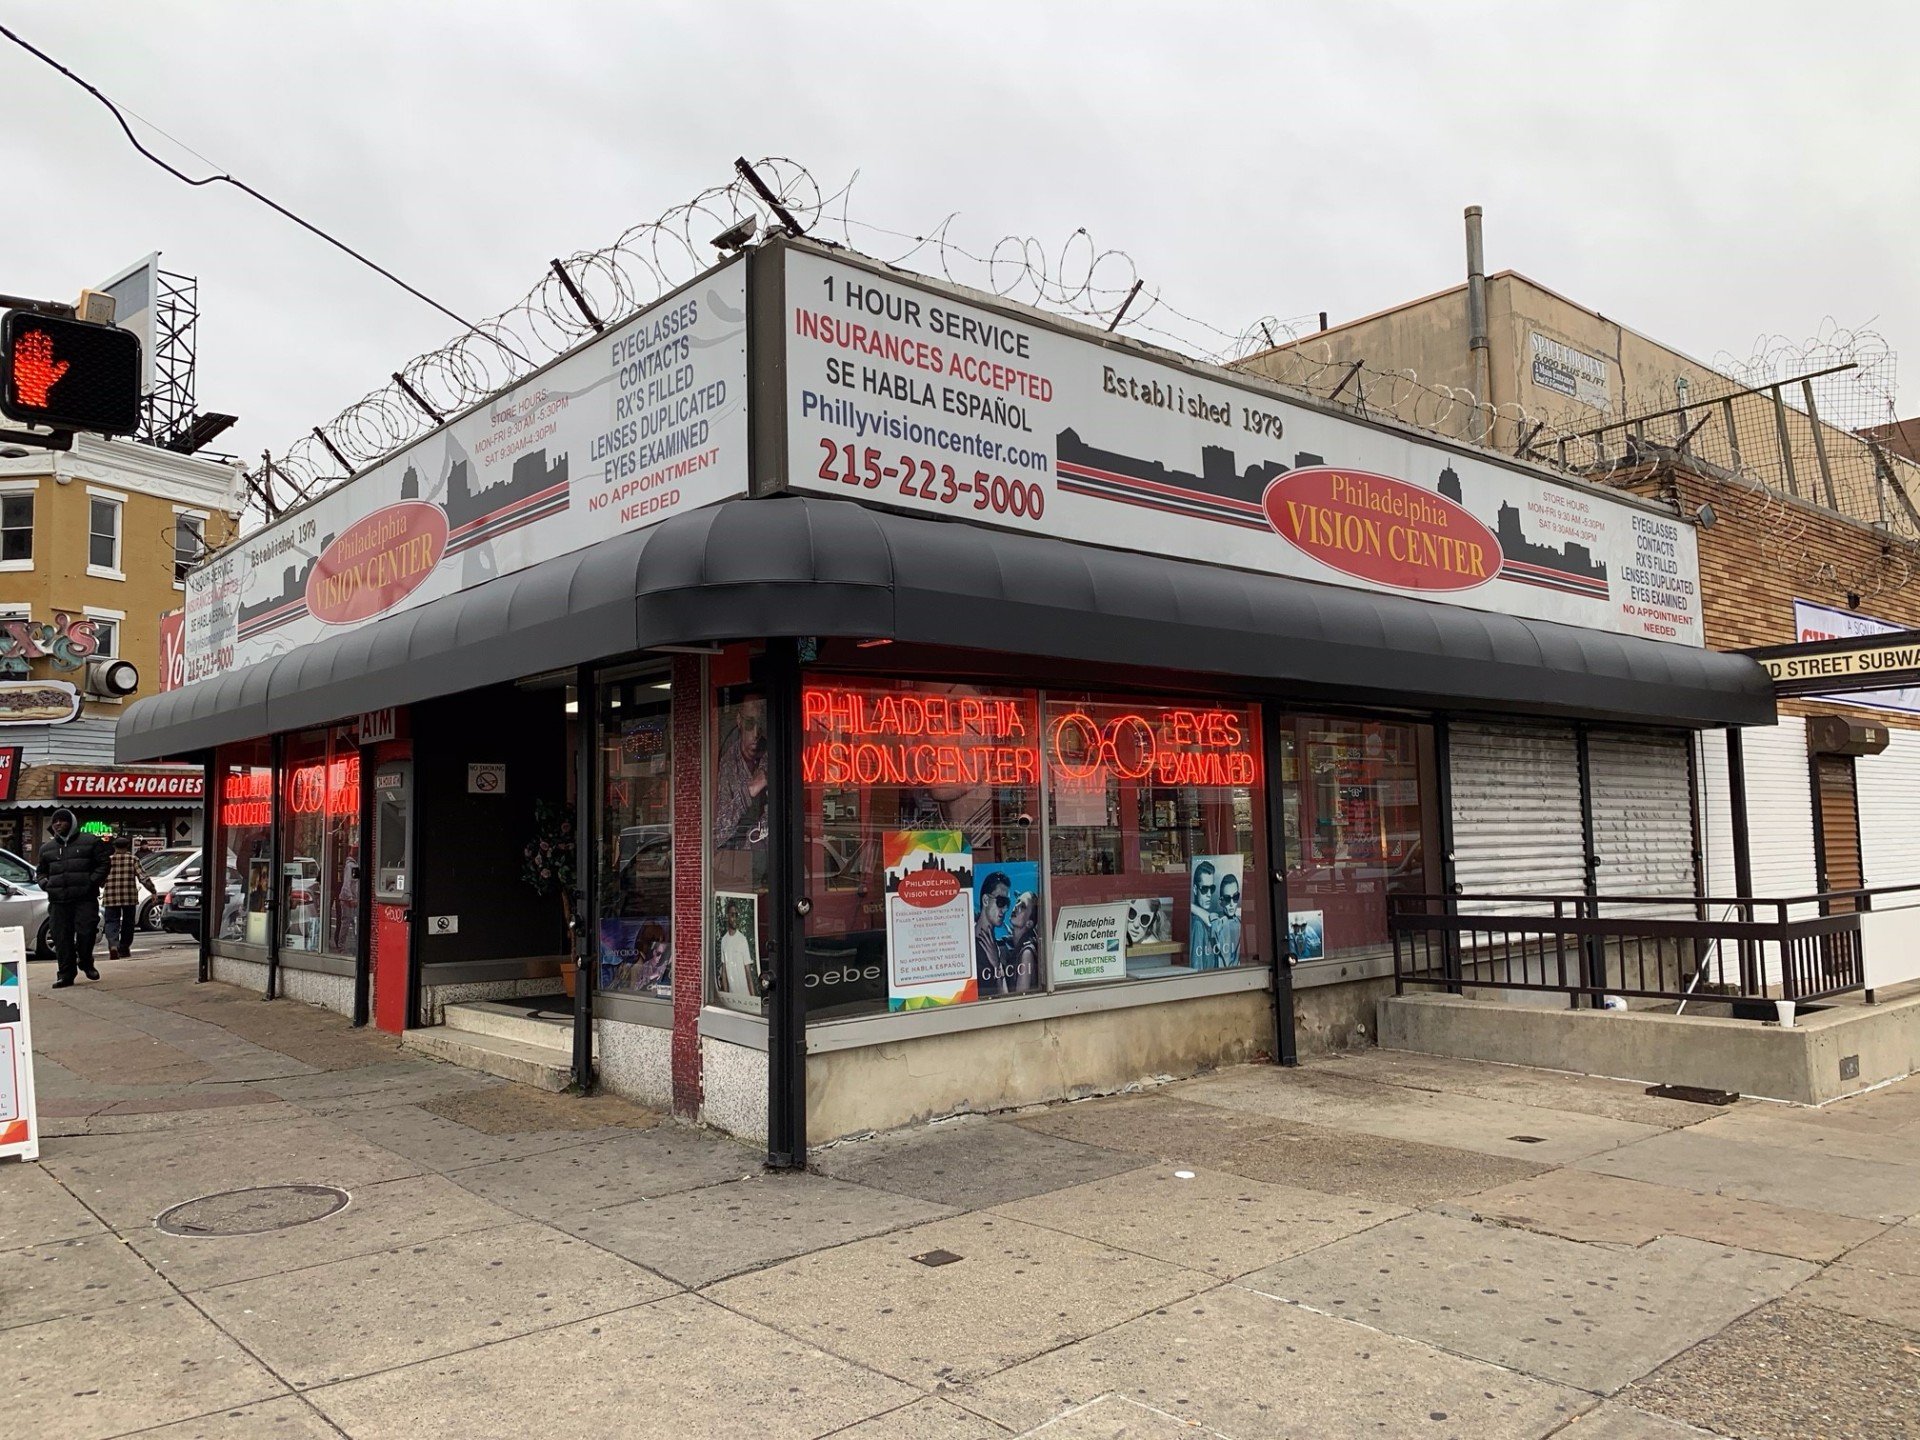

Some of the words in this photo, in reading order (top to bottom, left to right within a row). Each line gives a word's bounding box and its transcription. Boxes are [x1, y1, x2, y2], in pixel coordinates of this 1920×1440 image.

[824, 276, 834, 301] 1
[846, 281, 921, 328] HOUR
[929, 307, 1030, 359] SERVICE
[612, 300, 697, 367] EYEGLASSES
[620, 334, 689, 390] CONTACTS
[795, 307, 943, 373] INSURANCES
[950, 353, 1053, 403] ACCEPTED
[1560, 363, 1580, 378] PLUS
[616, 392, 644, 421] RX'S
[648, 364, 694, 407] FILLED
[826, 357, 855, 388] SE
[863, 367, 936, 409] HABLA
[943, 387, 1032, 432] ESPAÑOL
[1102, 365, 1232, 427] Established
[1243, 407, 1284, 440] 1979
[491, 405, 517, 428] STORE
[591, 420, 637, 462] LENSES
[641, 379, 726, 440] DUPLICATED
[802, 390, 1048, 472] Phillyvisioncenter.com
[475, 429, 506, 455] MON-FRI
[523, 413, 536, 431] AM
[485, 450, 499, 467] SAT
[605, 450, 636, 484] EYES
[639, 419, 709, 470] EXAMINED
[589, 493, 608, 512] NO
[611, 447, 719, 504] APPOINTMENT
[818, 438, 1045, 520] 215-223-5000
[620, 489, 680, 523] NEEDED
[1331, 473, 1448, 528] Philadelphia
[1527, 501, 1557, 519] MON-FRI
[1571, 512, 1581, 524] AM
[1542, 491, 1565, 509] STORE
[337, 510, 407, 564] Philadelphia
[1286, 500, 1382, 558] VISION
[1388, 525, 1486, 578] CENTER
[1538, 518, 1552, 530] SAT
[1631, 515, 1678, 542] EYEGLASSES
[251, 529, 296, 569] Established
[298, 519, 317, 544] 1979
[1636, 534, 1675, 558] CONTACTS
[315, 563, 364, 611] VISION
[366, 532, 434, 592] CENTER
[1635, 551, 1653, 569] RX'S
[1654, 556, 1678, 575] FILLED
[1621, 566, 1649, 587] LENSES
[1651, 574, 1694, 596] DUPLICATED
[1630, 585, 1650, 603] EYES
[1651, 591, 1688, 611] EXAMINED
[1622, 603, 1635, 615] NO
[1637, 607, 1694, 625] APPOINTMENT
[1644, 623, 1677, 637] NEEDED
[1787, 656, 1853, 677] STREET
[362, 708, 392, 739] ATM
[804, 691, 1026, 737] PHILADELPHIA
[1172, 710, 1242, 747] EYES
[803, 742, 906, 784] VISION
[914, 744, 1036, 785] CENTER
[1159, 751, 1255, 785] EXAMINED
[903, 890, 928, 899] VISION
[930, 888, 958, 898] CENTER
[905, 879, 956, 888] PHILADELPHIA
[1063, 930, 1088, 942] Vision
[1090, 928, 1117, 940] Center
[1065, 916, 1116, 930] Philadelphia
[908, 955, 943, 963] APPOINTMENT
[1059, 958, 1084, 968] HEALTH
[1085, 955, 1117, 966] PARTNERS
[1070, 941, 1105, 953] WELCOMES
[1195, 942, 1238, 957] GUCCI
[911, 964, 933, 972] HABLA
[935, 960, 965, 970] ESPAÑOL
[981, 962, 1032, 981] GUCCI
[1073, 965, 1105, 976] MEMBERS
